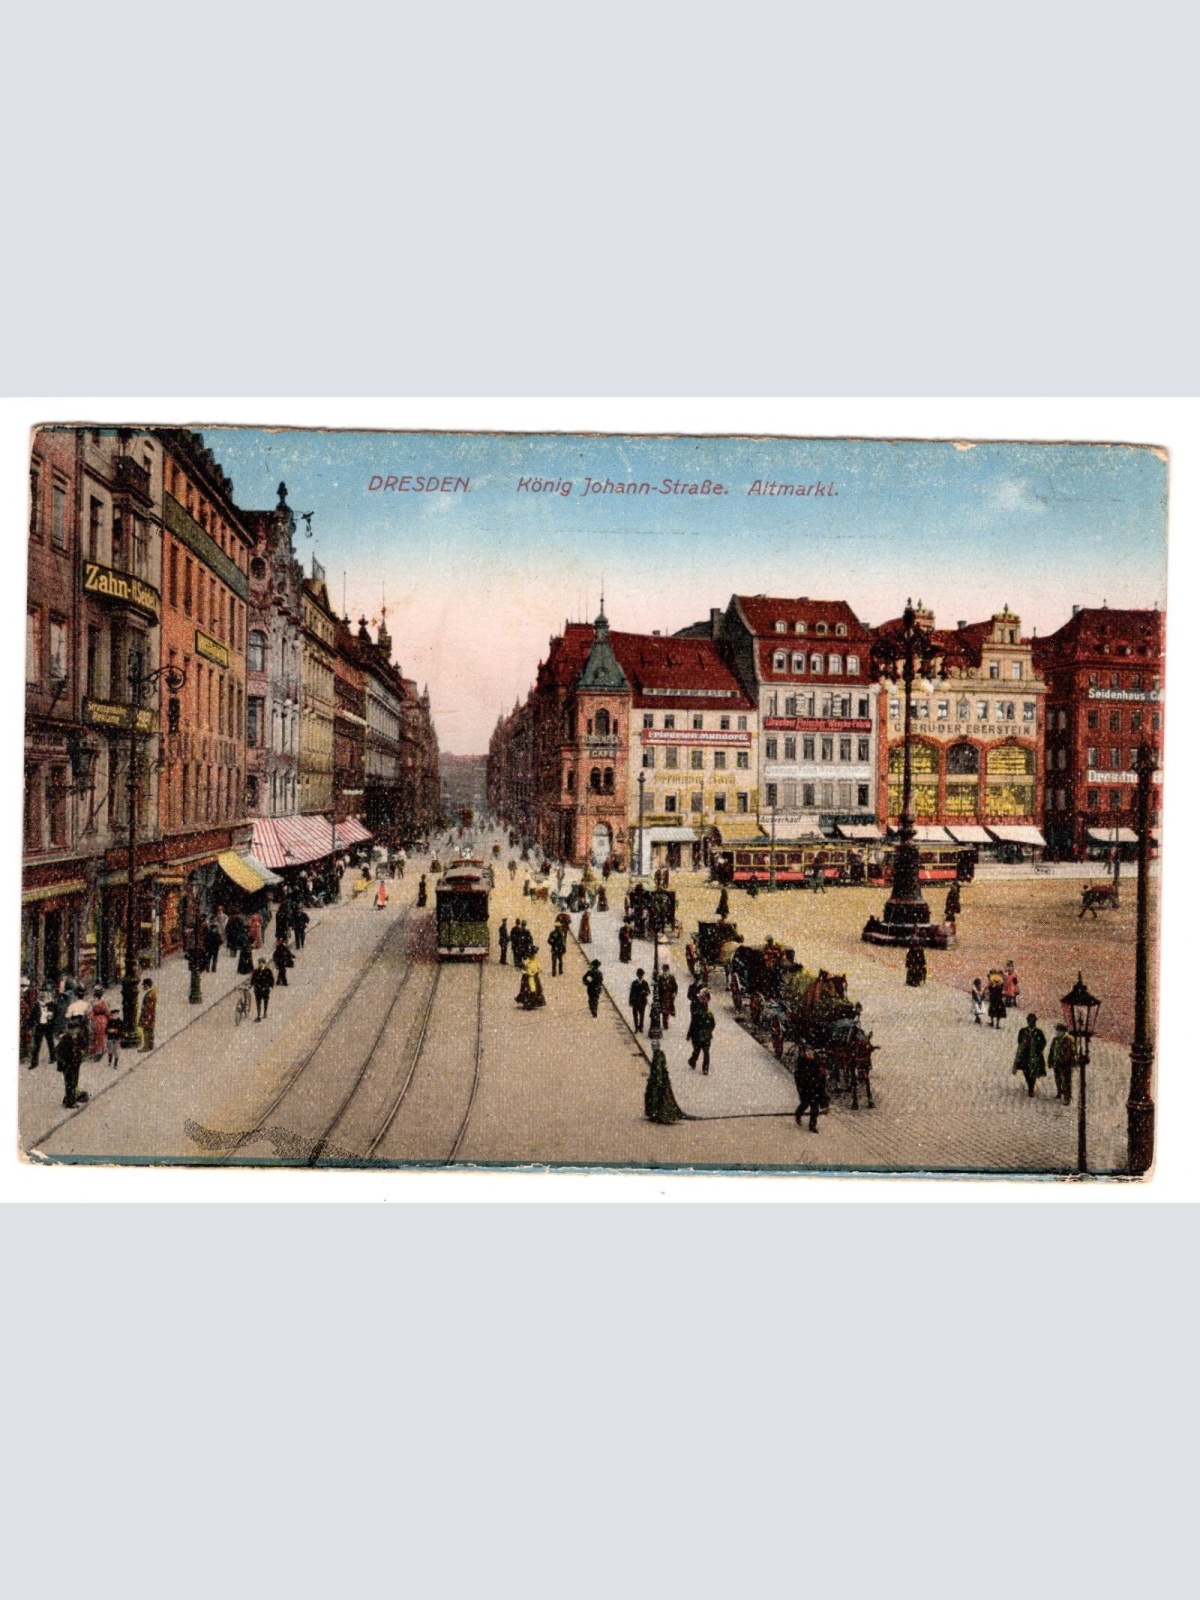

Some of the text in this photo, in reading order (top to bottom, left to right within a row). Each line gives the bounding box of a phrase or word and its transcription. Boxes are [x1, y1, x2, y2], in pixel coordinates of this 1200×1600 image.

[1088, 687, 1146, 701] Seidenhaus
[894, 720, 1031, 735] GBRÜDER EBERSTEIN
